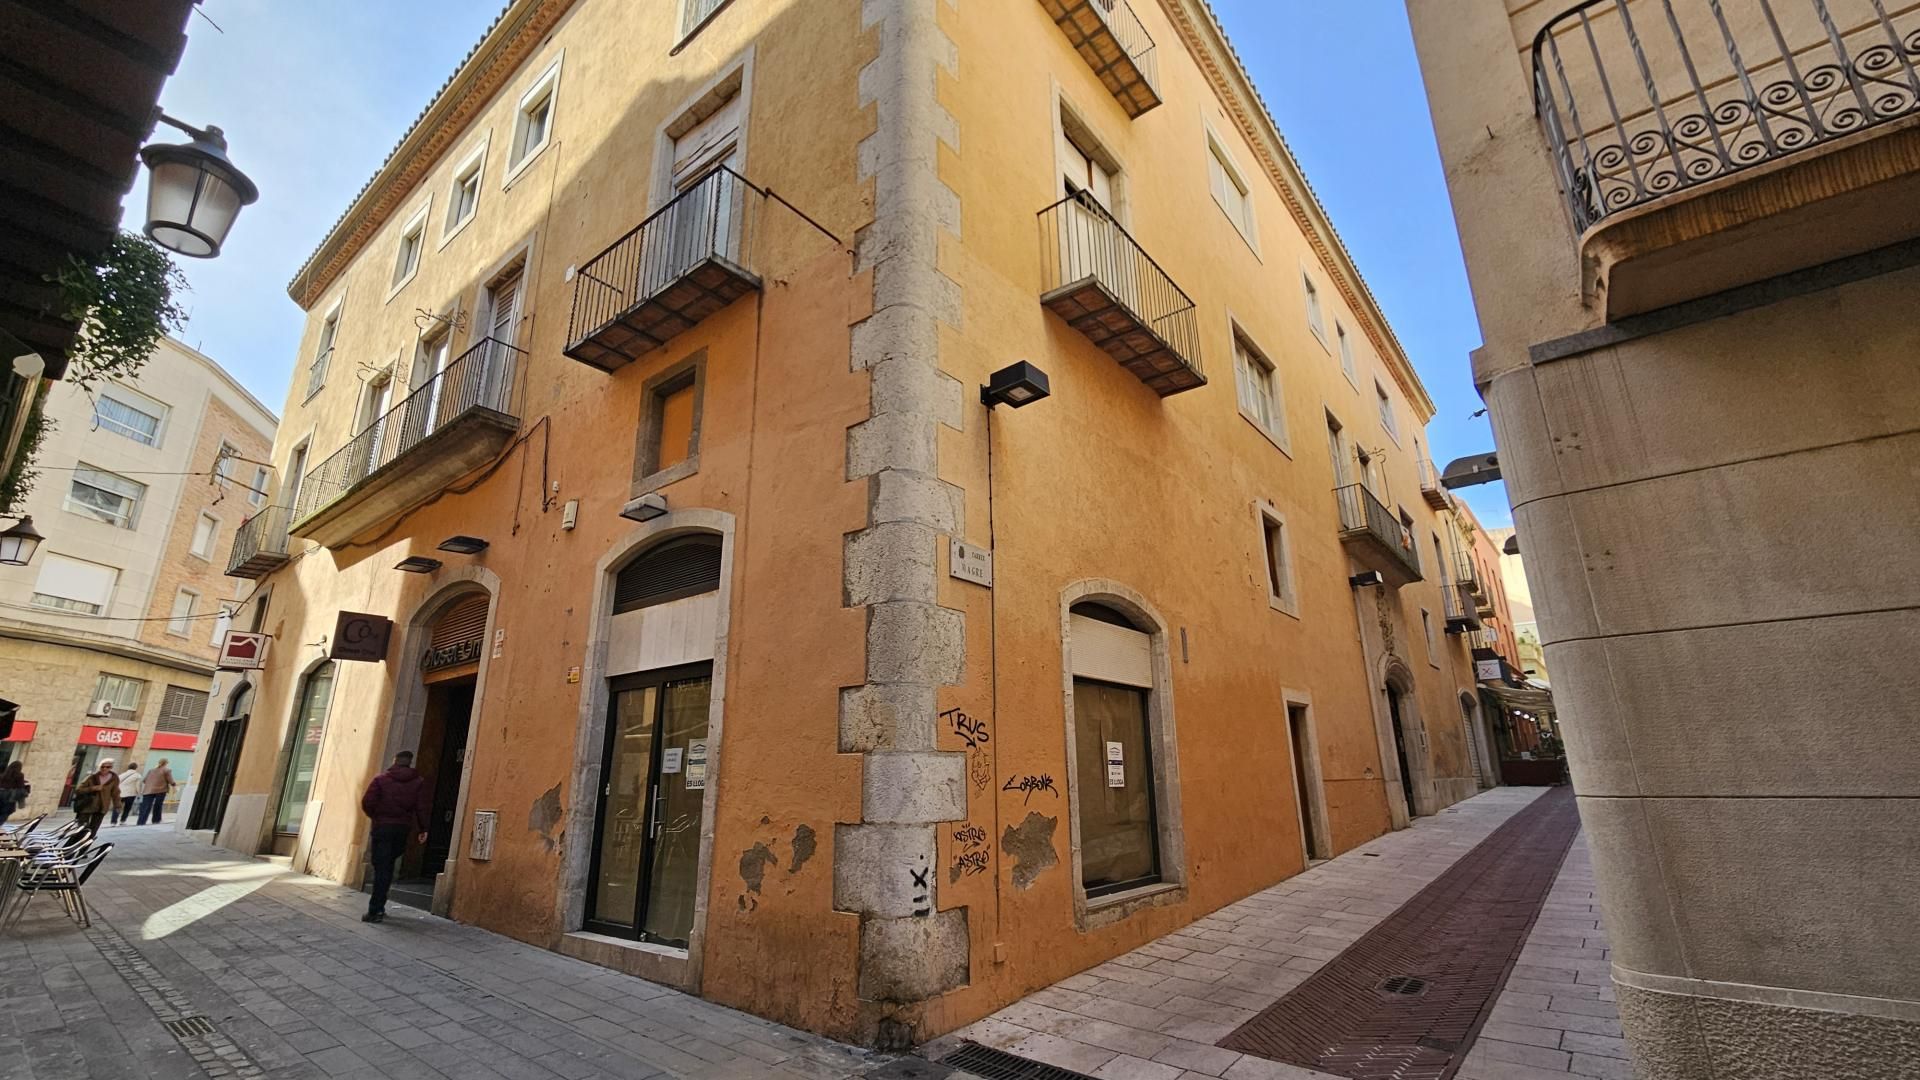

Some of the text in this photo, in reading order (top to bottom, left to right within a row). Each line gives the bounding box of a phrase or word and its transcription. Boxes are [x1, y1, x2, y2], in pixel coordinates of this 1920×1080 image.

[939, 707, 989, 742] TRUS
[96, 729, 123, 744] GAES
[693, 779, 704, 787] LLOG
